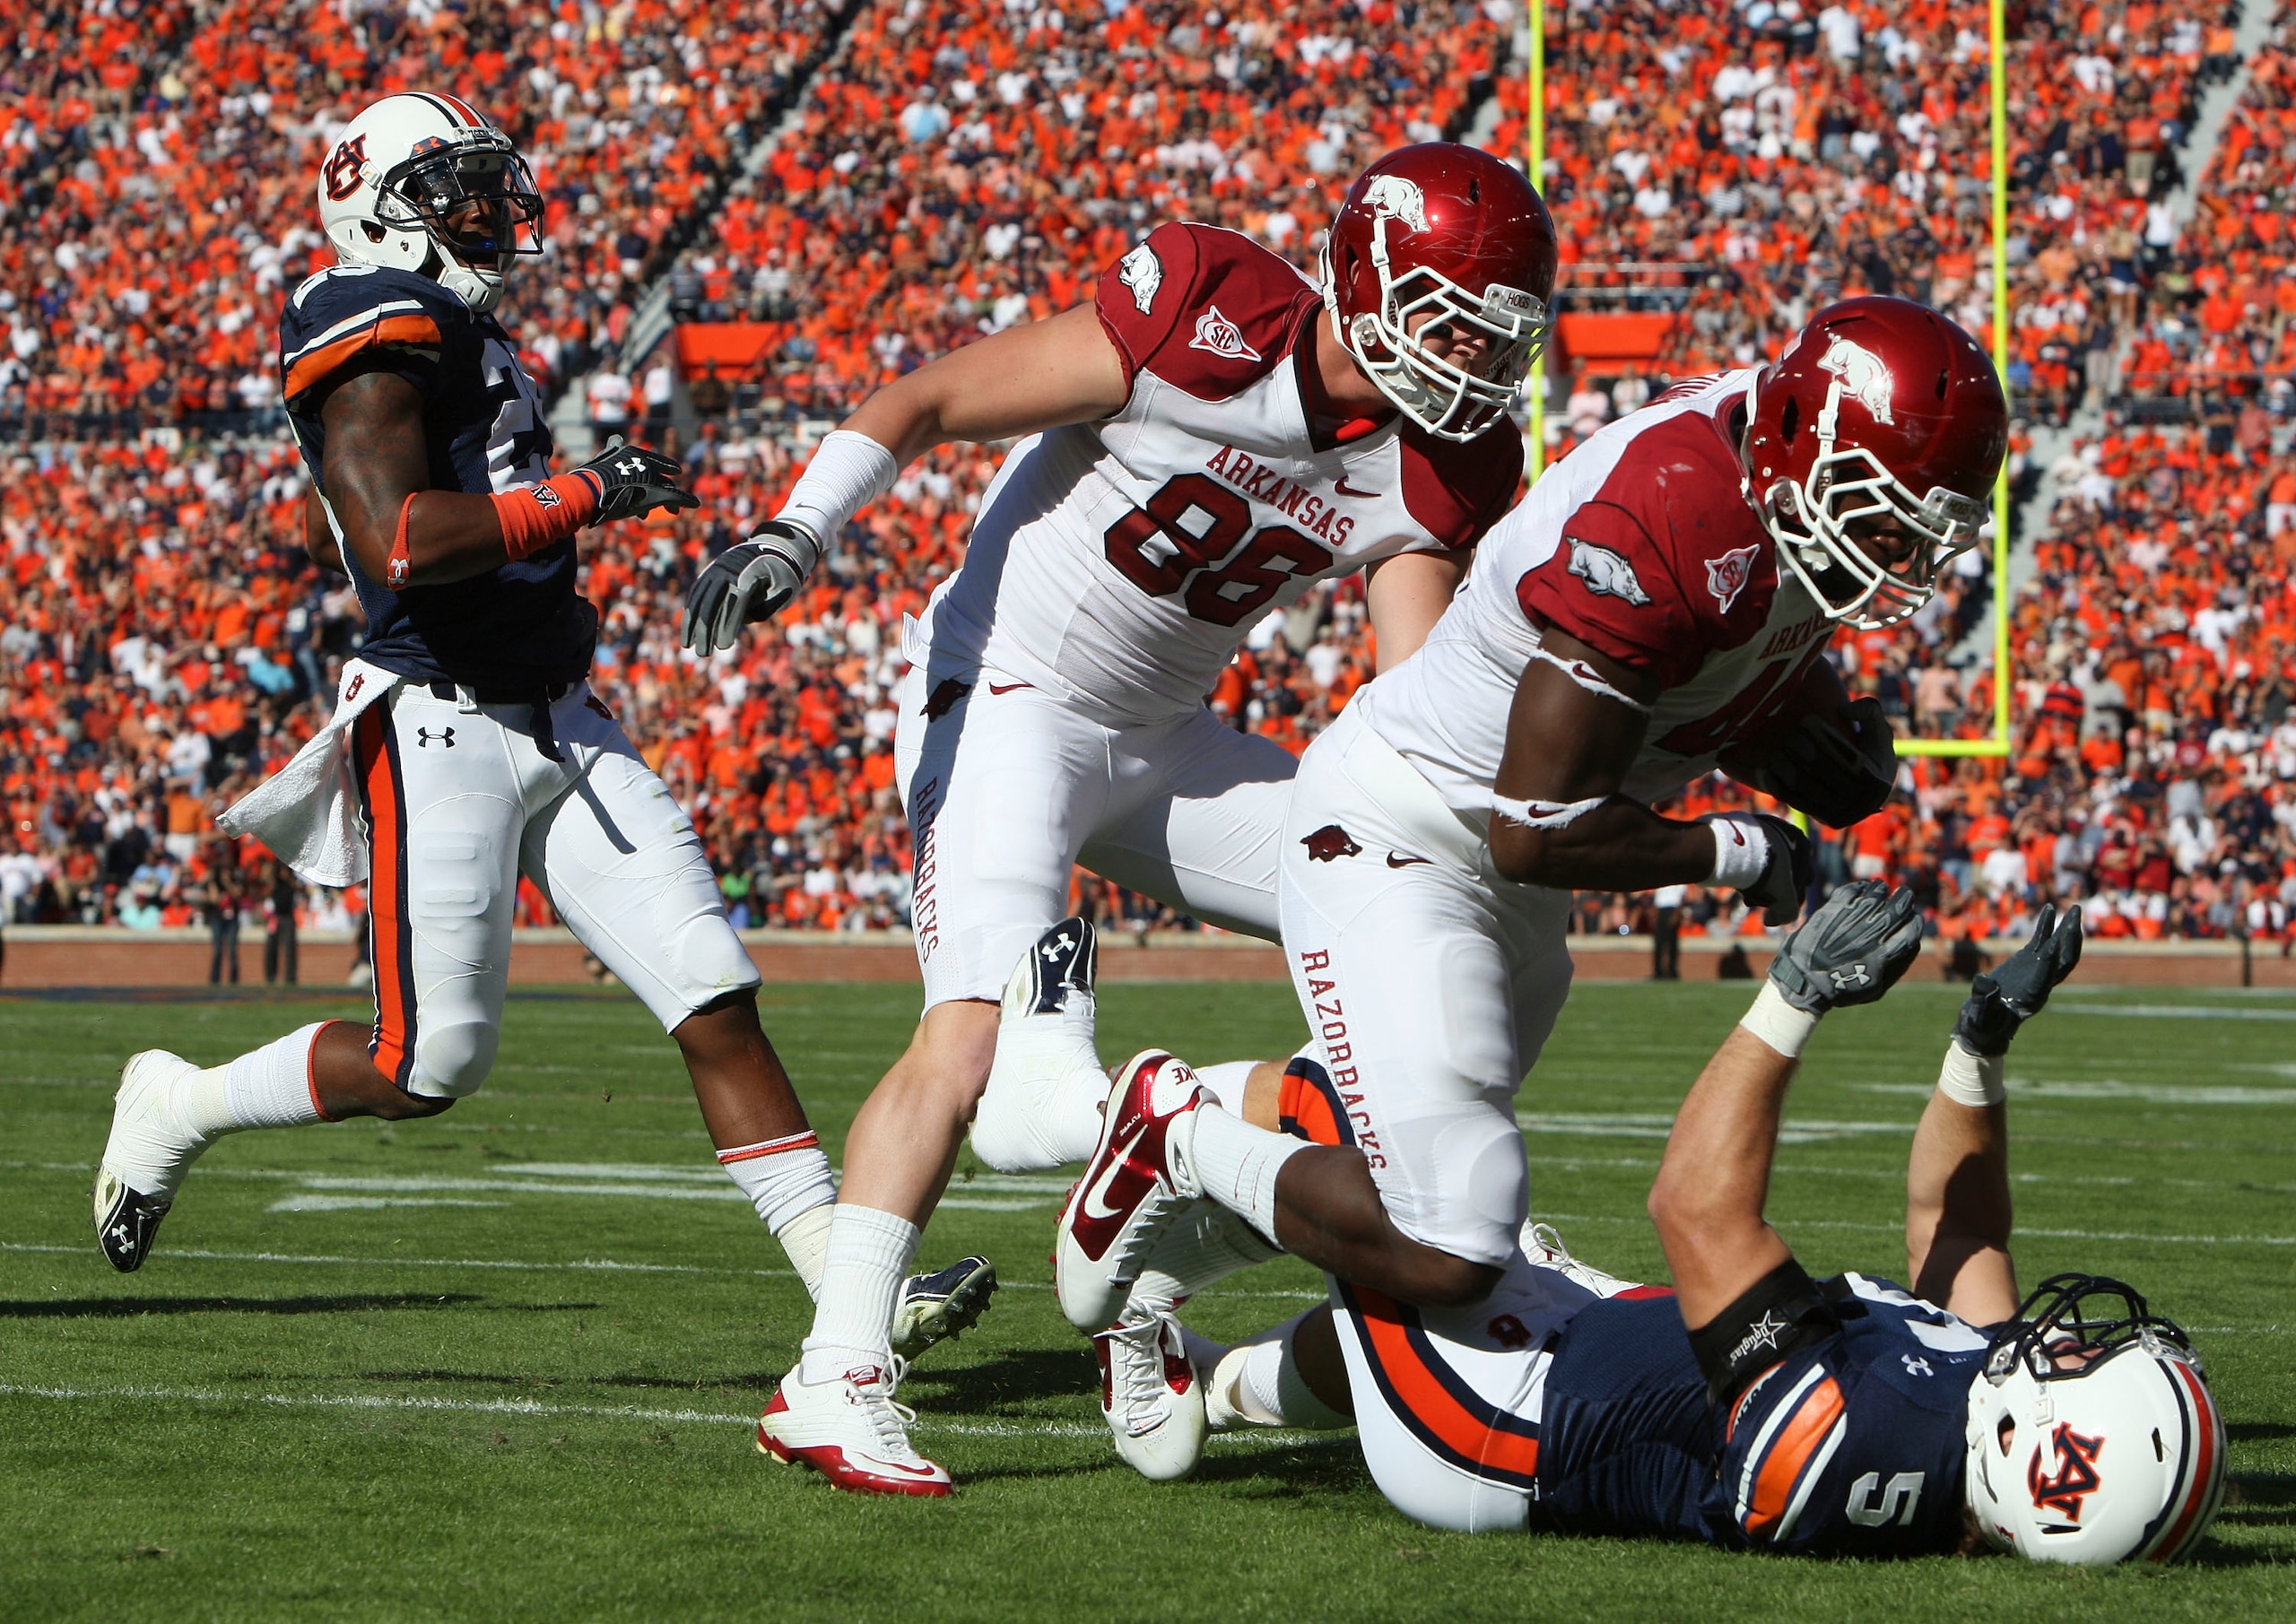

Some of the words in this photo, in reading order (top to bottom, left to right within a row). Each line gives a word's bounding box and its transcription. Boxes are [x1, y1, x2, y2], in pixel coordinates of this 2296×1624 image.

[1211, 325, 1235, 351] SEC
[1506, 293, 1530, 309] HOGS
[481, 338, 552, 495] 2
[1206, 444, 1354, 546] ARKANSAS
[1104, 473, 1334, 628] 86
[1721, 559, 1744, 588] SEC
[915, 777, 939, 964] RAZORBACKS
[1301, 949, 1387, 1169] RAZORBACKS
[1729, 1324, 1771, 1362] Douglas
